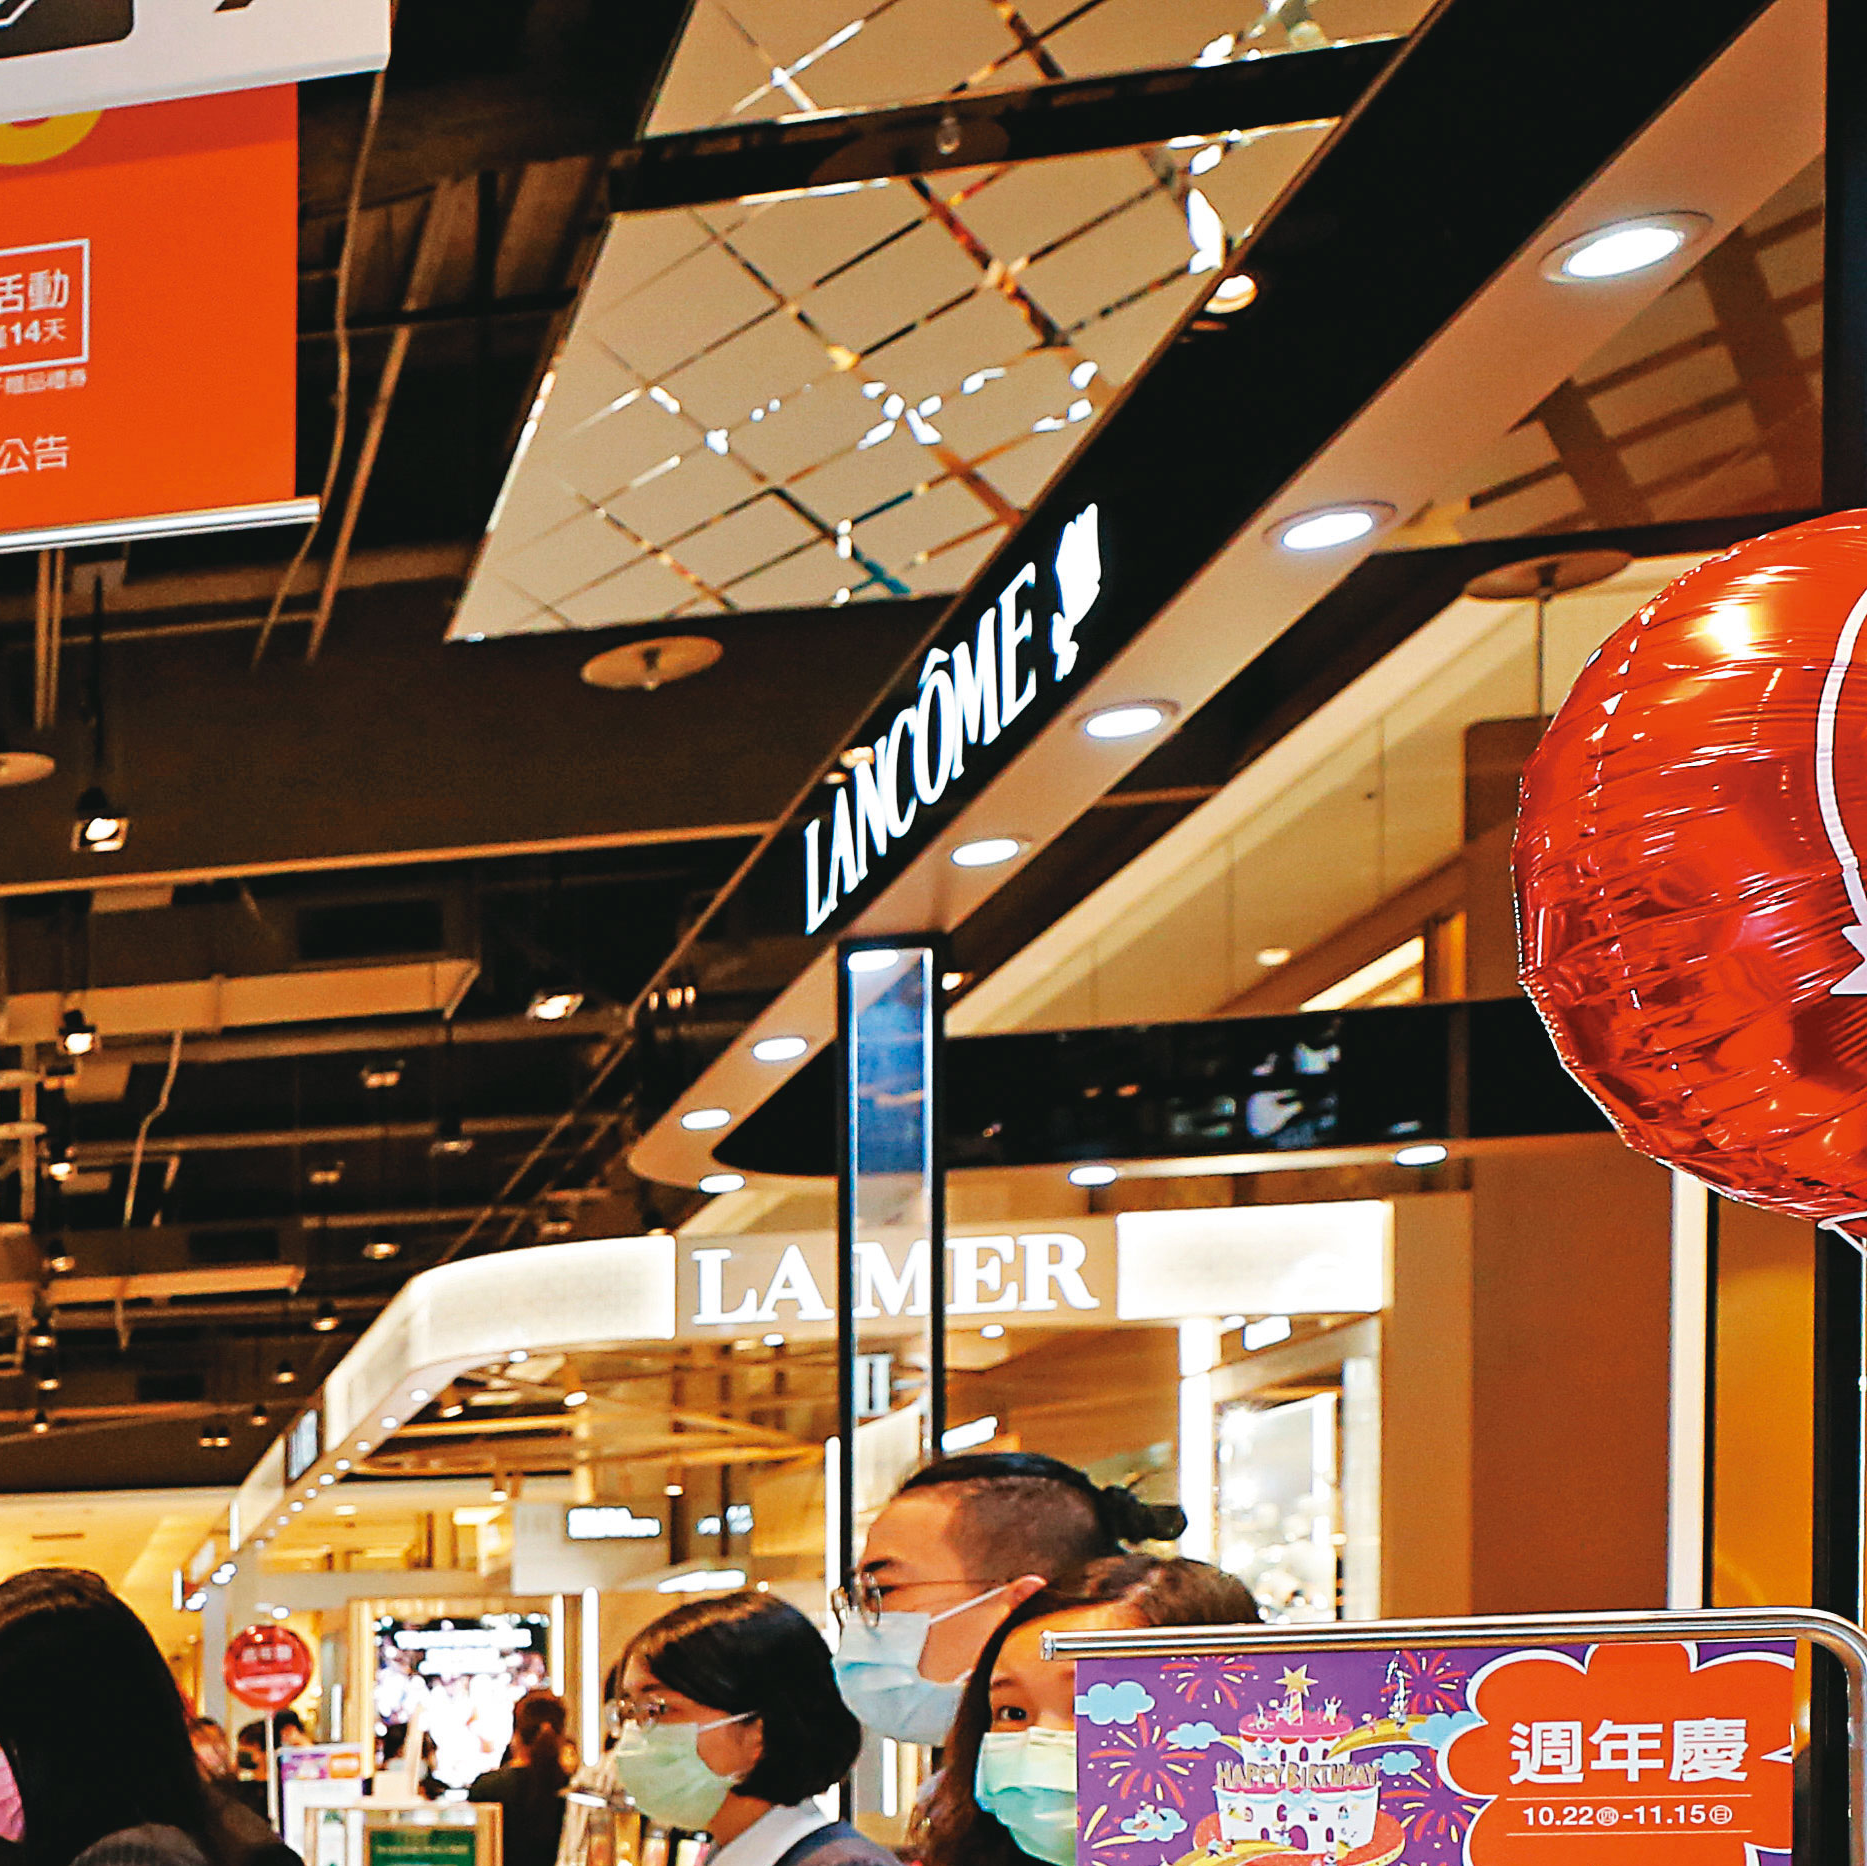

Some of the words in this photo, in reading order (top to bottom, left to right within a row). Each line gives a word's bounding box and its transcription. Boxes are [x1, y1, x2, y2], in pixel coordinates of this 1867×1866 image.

[804, 561, 1037, 935] LANCÔME
[692, 1243, 834, 1326] LA
[852, 1232, 1100, 1318] MER
[1216, 1760, 1286, 1789] HAPPY
[1287, 1762, 1381, 1789] BIRTHDAY
[1508, 1717, 1749, 1785] 週年慶
